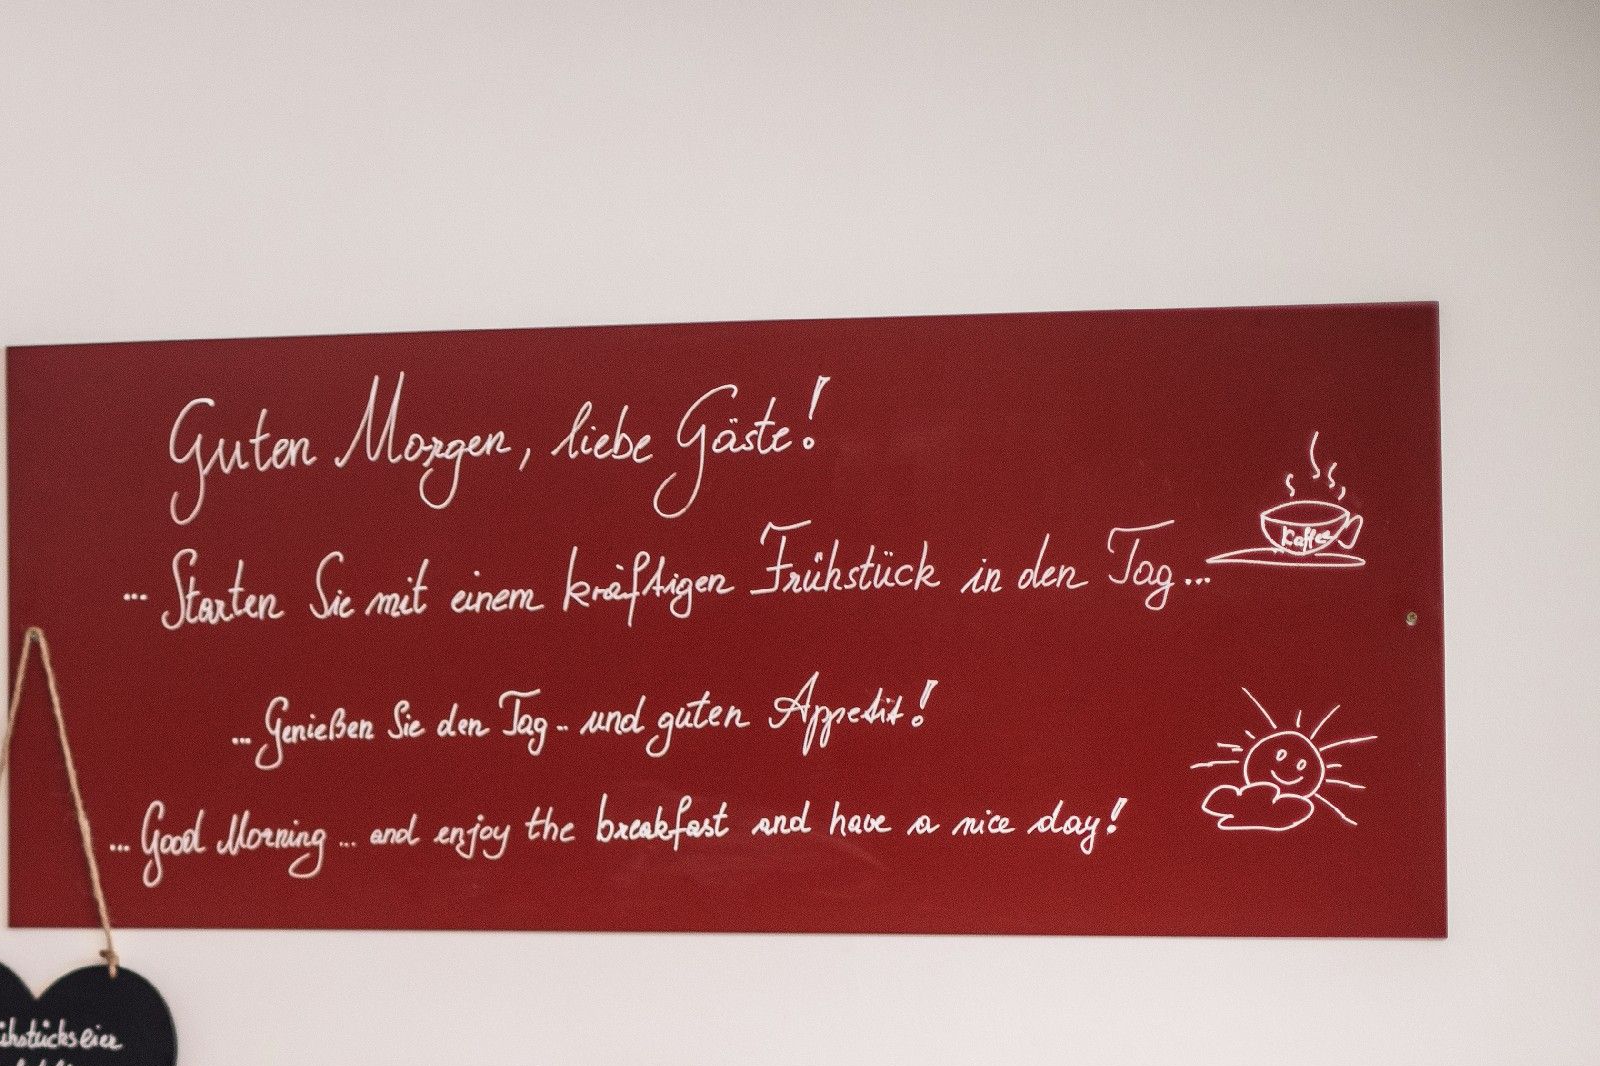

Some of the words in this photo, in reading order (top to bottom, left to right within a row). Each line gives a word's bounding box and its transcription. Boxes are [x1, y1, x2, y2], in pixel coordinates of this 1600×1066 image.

[169, 397, 315, 525] Guten
[334, 370, 531, 510] Morgen,
[550, 400, 653, 464] liebe
[652, 375, 831, 519] Gäste!
[309, 550, 355, 620] Sie
[364, 558, 430, 618] mit
[450, 570, 545, 614] einem
[562, 545, 735, 628] kräftigen
[749, 519, 941, 596] Frühstück
[960, 558, 1003, 594] in
[1017, 532, 1089, 590] den
[389, 699, 426, 740] Sie
[436, 702, 490, 738] den
[579, 694, 647, 736] und
[645, 690, 751, 758] guten
[768, 670, 939, 757] Appetit!
[216, 809, 327, 879] Morning
[369, 813, 420, 846] and
[433, 814, 511, 860] enjoy
[524, 809, 576, 843] the
[595, 792, 730, 852] breakfast
[751, 799, 812, 837] and
[829, 800, 893, 838] have
[906, 814, 941, 836] a
[951, 809, 1016, 836] nice
[1026, 796, 1129, 856] day!
